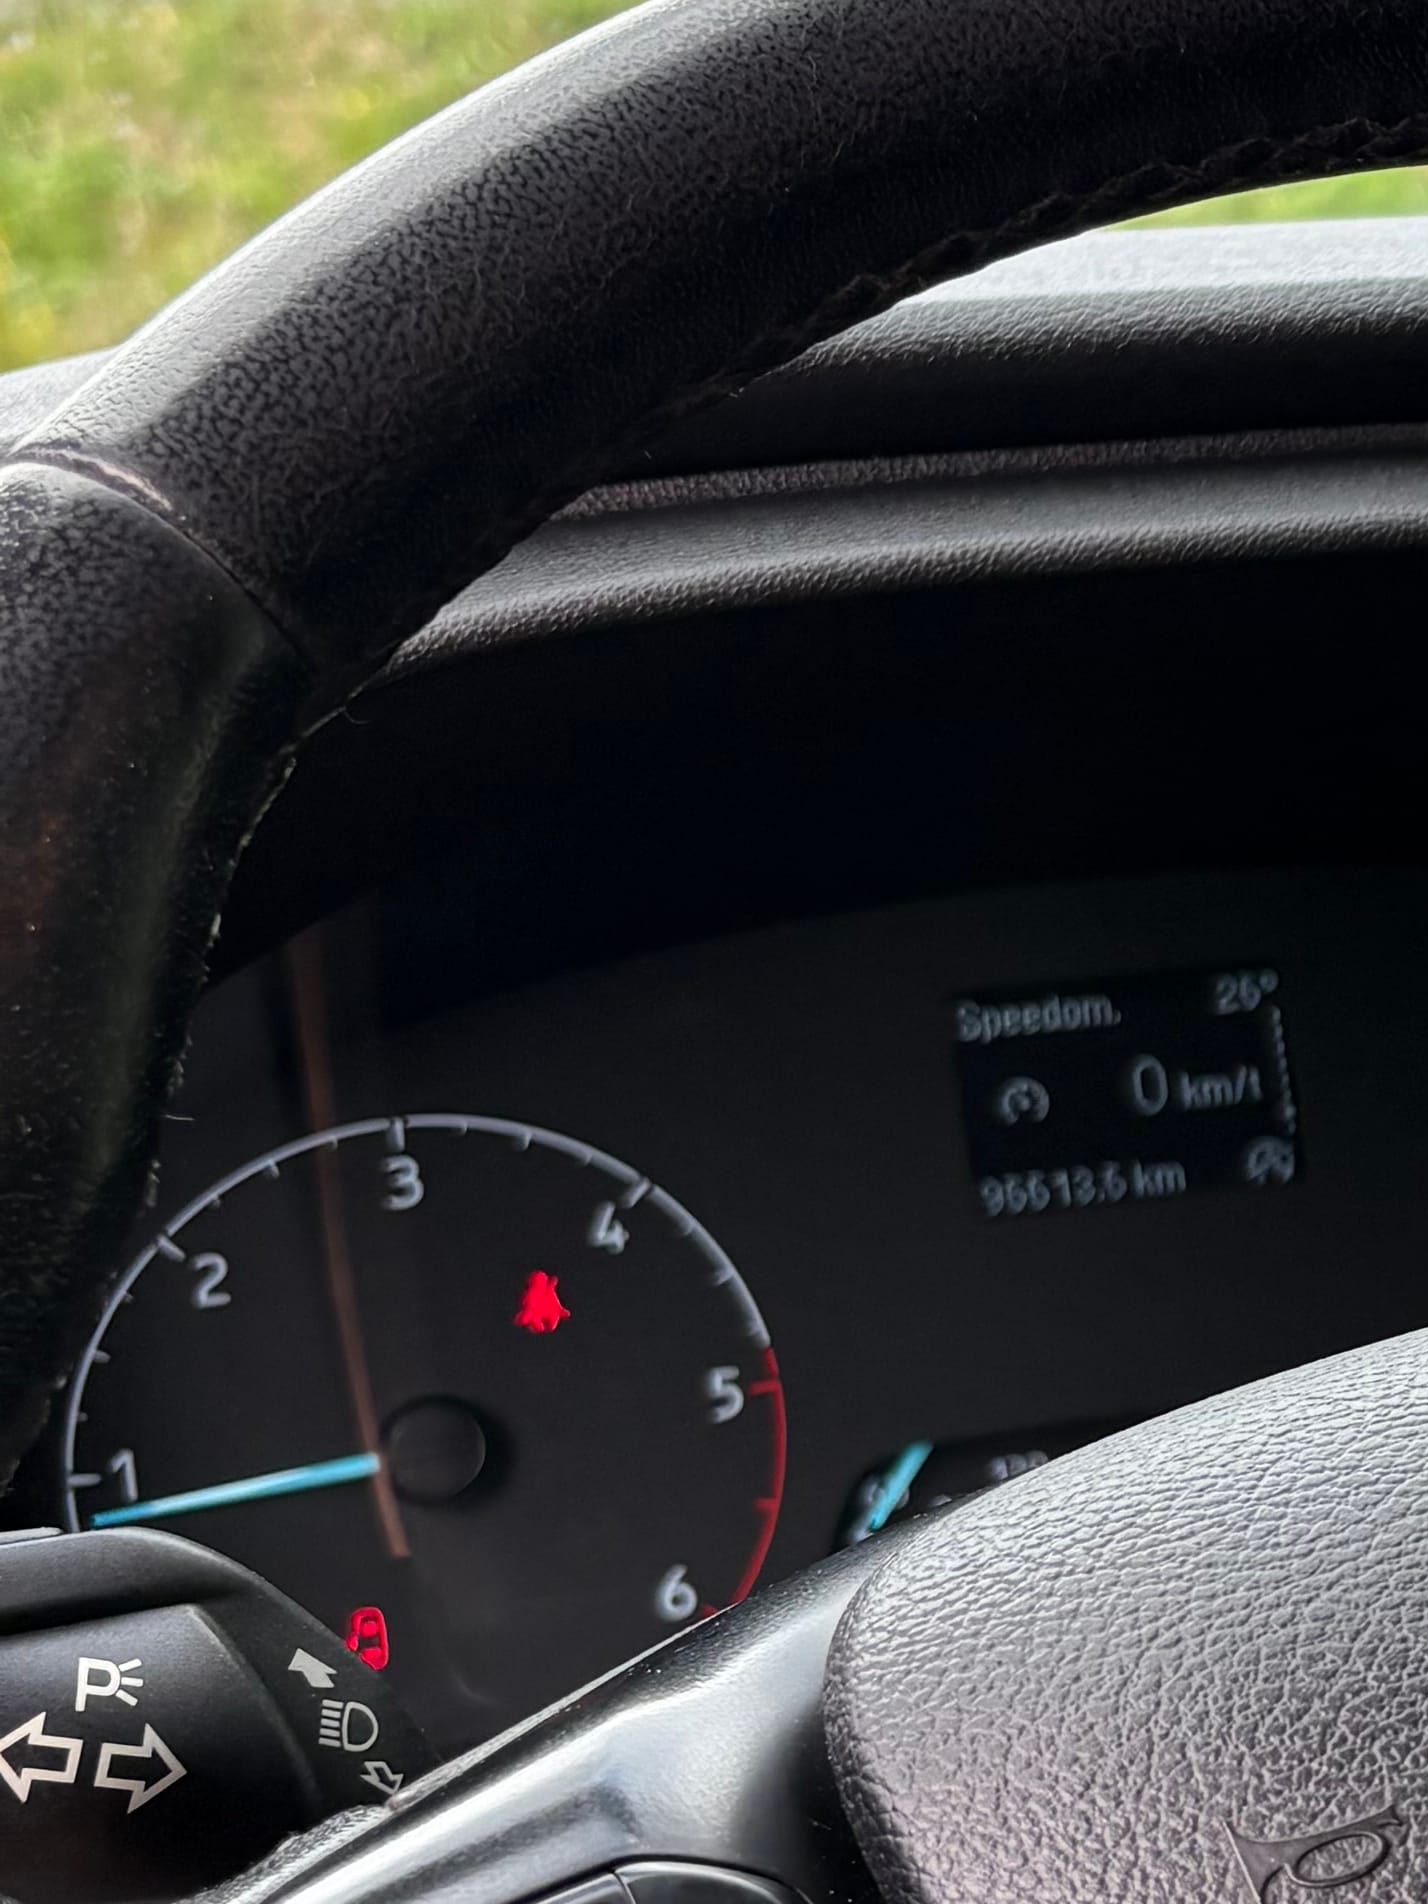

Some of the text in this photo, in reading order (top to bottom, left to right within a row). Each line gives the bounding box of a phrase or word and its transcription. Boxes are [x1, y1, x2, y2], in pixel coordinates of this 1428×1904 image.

[956, 994, 1121, 1044] Speedom.
[1129, 1053, 1168, 1115] 0
[381, 1156, 424, 1209] 3
[1129, 1157, 1187, 1195] km
[589, 1202, 630, 1254] 4
[189, 1251, 232, 1309] 2
[704, 1367, 746, 1424] 5
[109, 1448, 138, 1501] 1
[655, 1564, 700, 1622] 6
